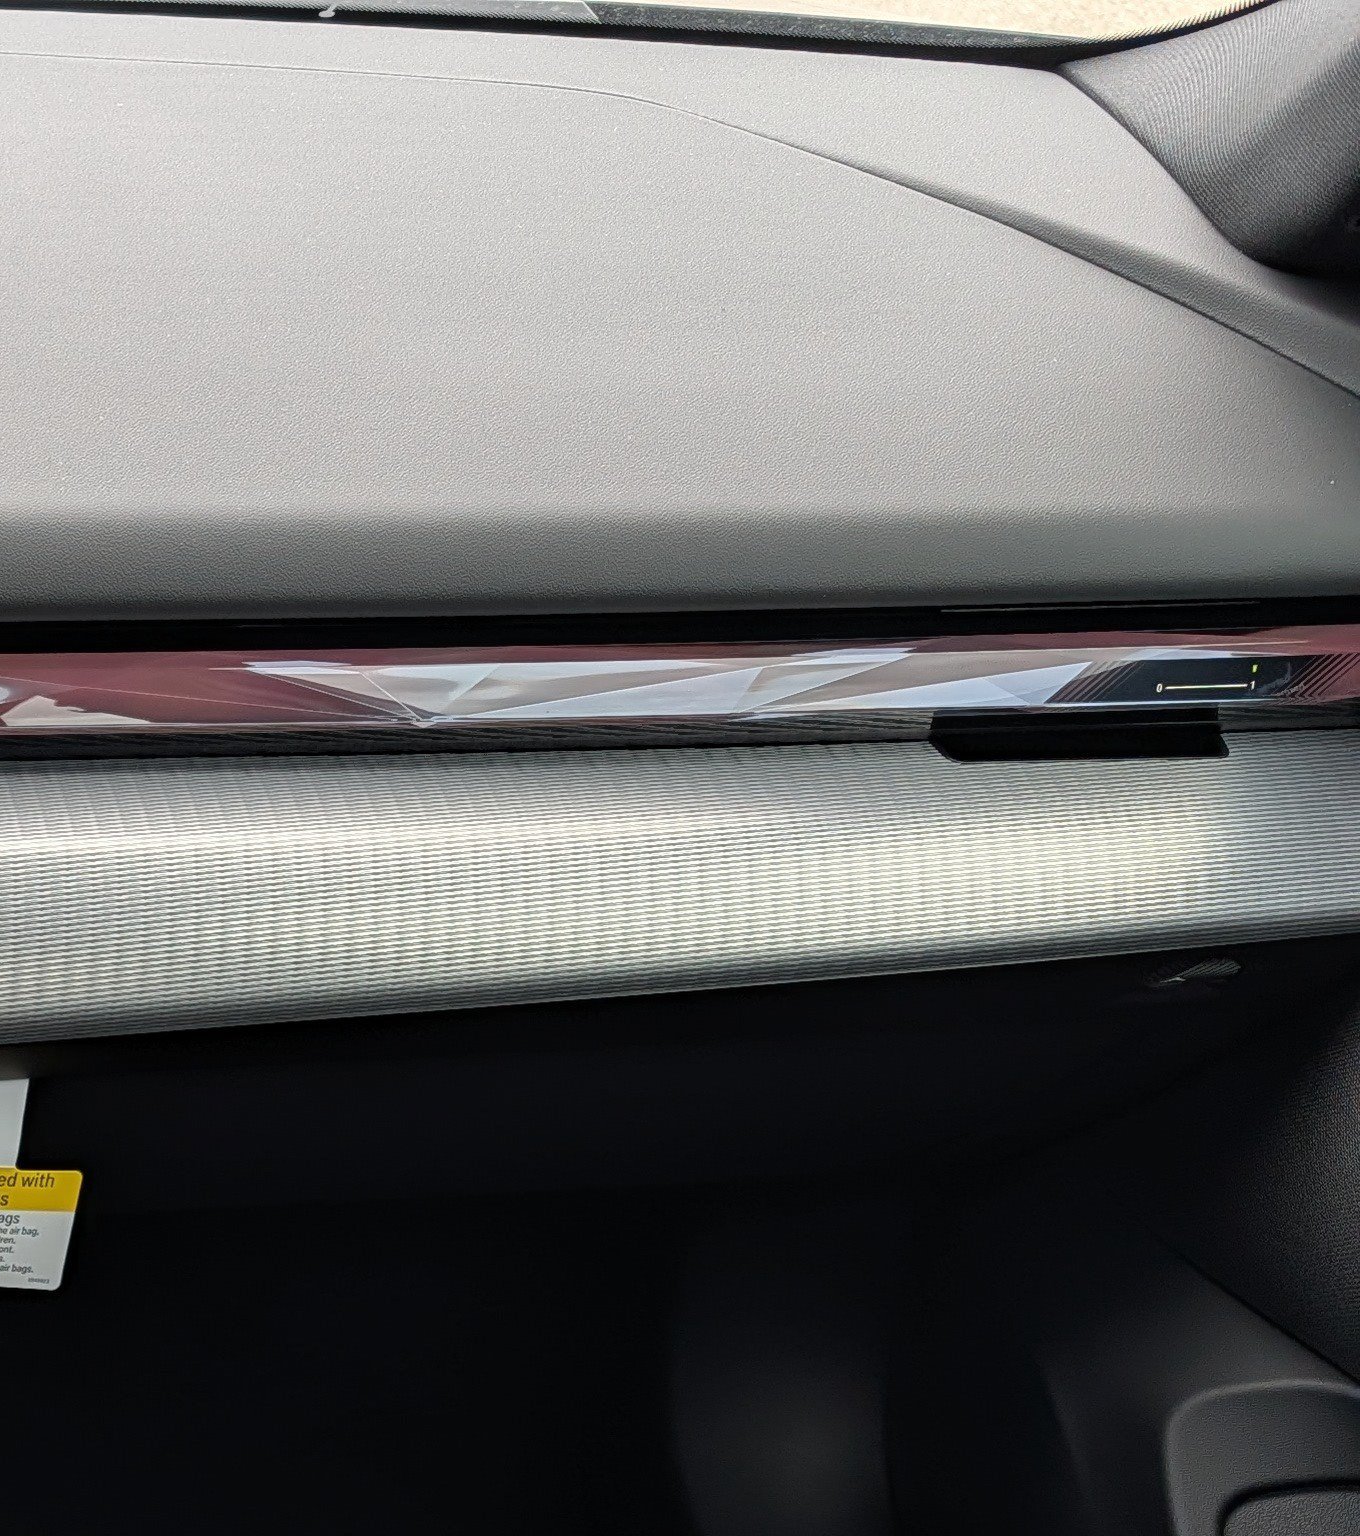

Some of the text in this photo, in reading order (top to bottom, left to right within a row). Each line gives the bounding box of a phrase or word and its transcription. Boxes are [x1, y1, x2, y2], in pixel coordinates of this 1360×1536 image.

[21, 1173, 56, 1188] with
[9, 1227, 21, 1235] air
[21, 1227, 40, 1238] bag.
[0, 1264, 11, 1272] air
[11, 1264, 34, 1275] bags.
